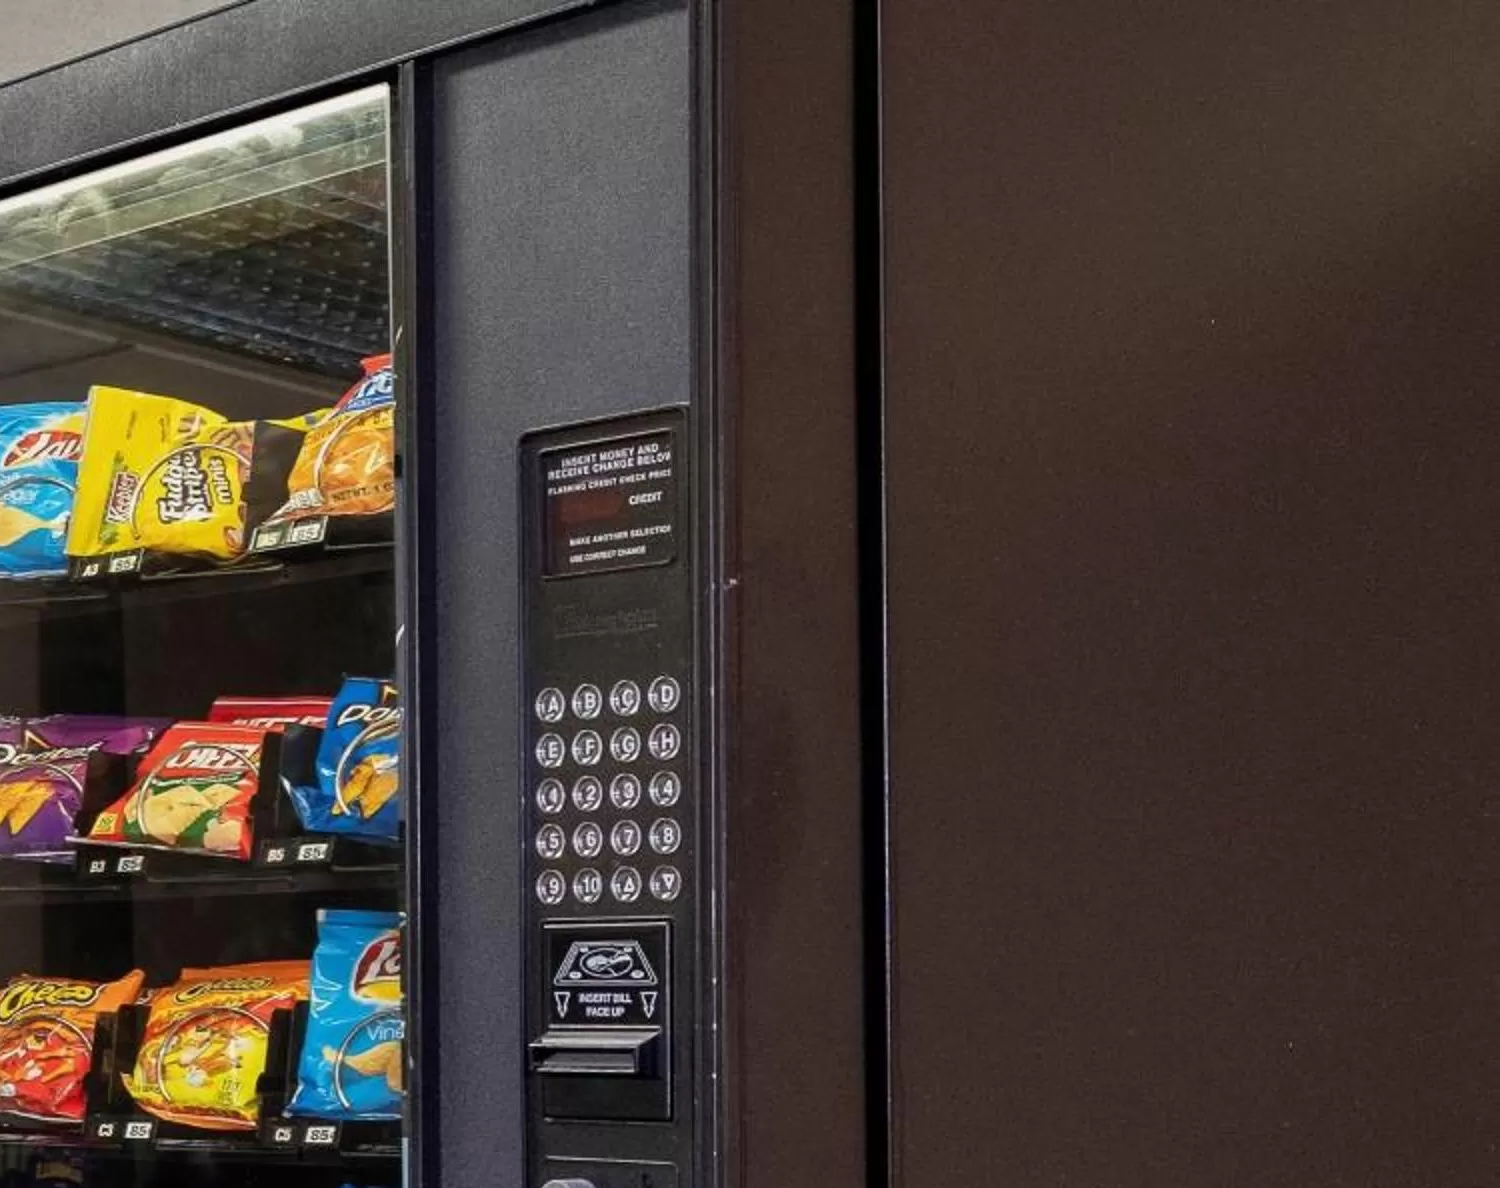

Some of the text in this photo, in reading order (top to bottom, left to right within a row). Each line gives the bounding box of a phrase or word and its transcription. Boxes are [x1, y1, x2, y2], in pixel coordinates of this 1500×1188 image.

[561, 443, 659, 468] INSERT MONEY AND
[547, 464, 590, 481] RECEIVE
[592, 457, 634, 473] CHANGE
[209, 457, 232, 504] minis
[628, 491, 663, 505] CREDIT
[569, 534, 591, 547] MAKE
[592, 529, 629, 544] ANOTHER
[548, 696, 559, 713] A
[585, 692, 596, 709] B
[662, 685, 674, 702] D
[548, 732, 674, 757] E F G H
[586, 784, 597, 801] 2
[662, 779, 674, 795] 4
[549, 827, 674, 849] 5 6 7 8
[549, 877, 599, 895] 9 10
[612, 992, 633, 1004] BILL
[585, 1006, 626, 1017] FACE UP
